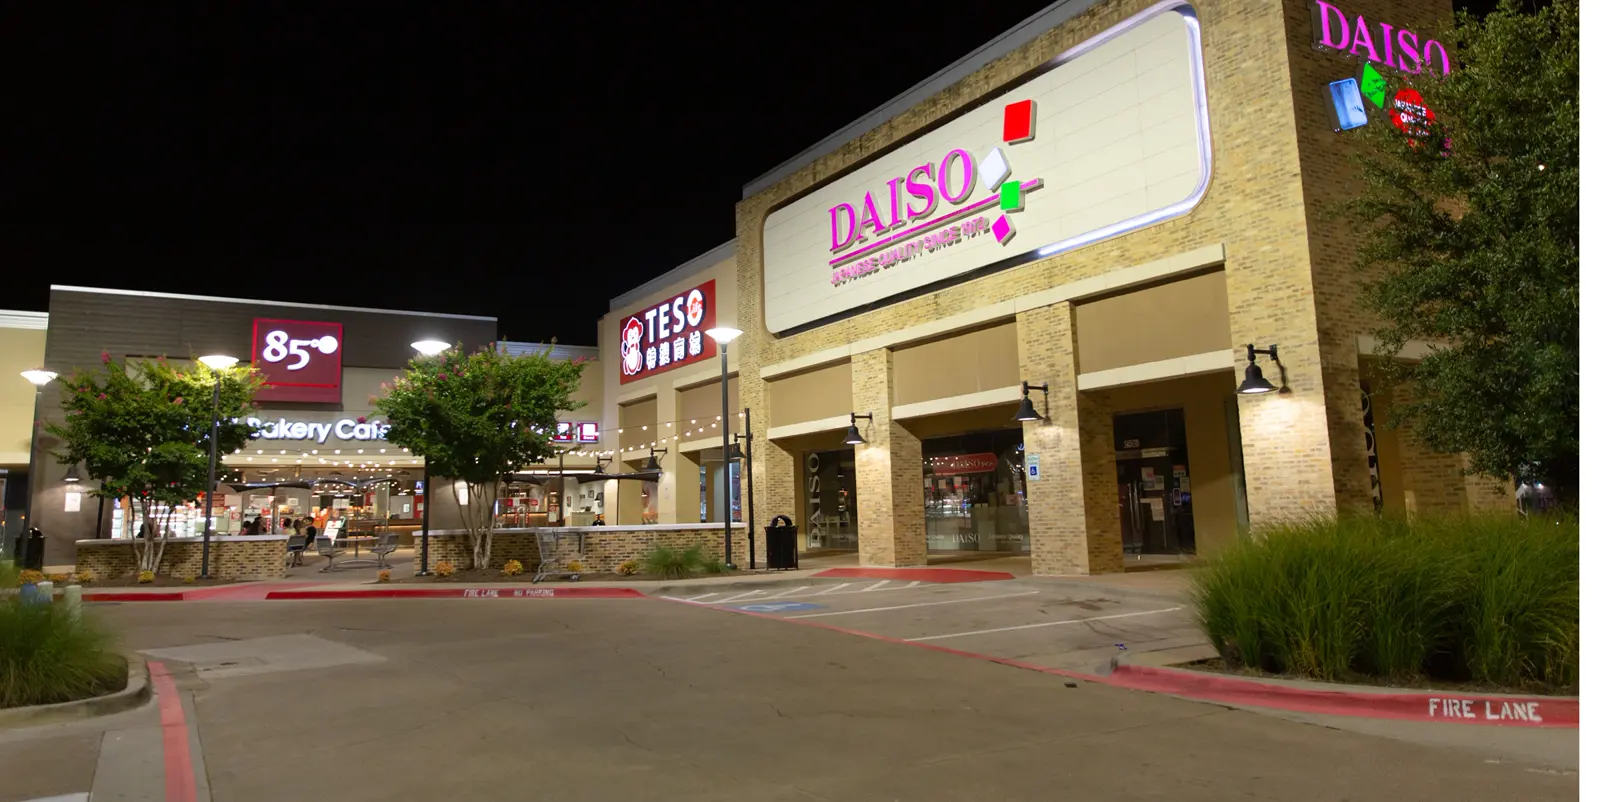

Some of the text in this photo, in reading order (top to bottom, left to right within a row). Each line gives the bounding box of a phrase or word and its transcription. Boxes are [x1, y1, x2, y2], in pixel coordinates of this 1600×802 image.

[1316, 0, 1450, 79] DAISO
[828, 148, 976, 252] DAISO
[831, 217, 987, 285] JAPANESE QUALITY SINCE 1972
[645, 289, 703, 343] TESO
[807, 453, 822, 549] DAISO
[952, 533, 980, 543] DAISO
[464, 589, 479, 597] FIRE
[481, 589, 499, 597] LANE
[526, 589, 554, 597] PARKING
[1429, 698, 1542, 722] FIRE LANE
